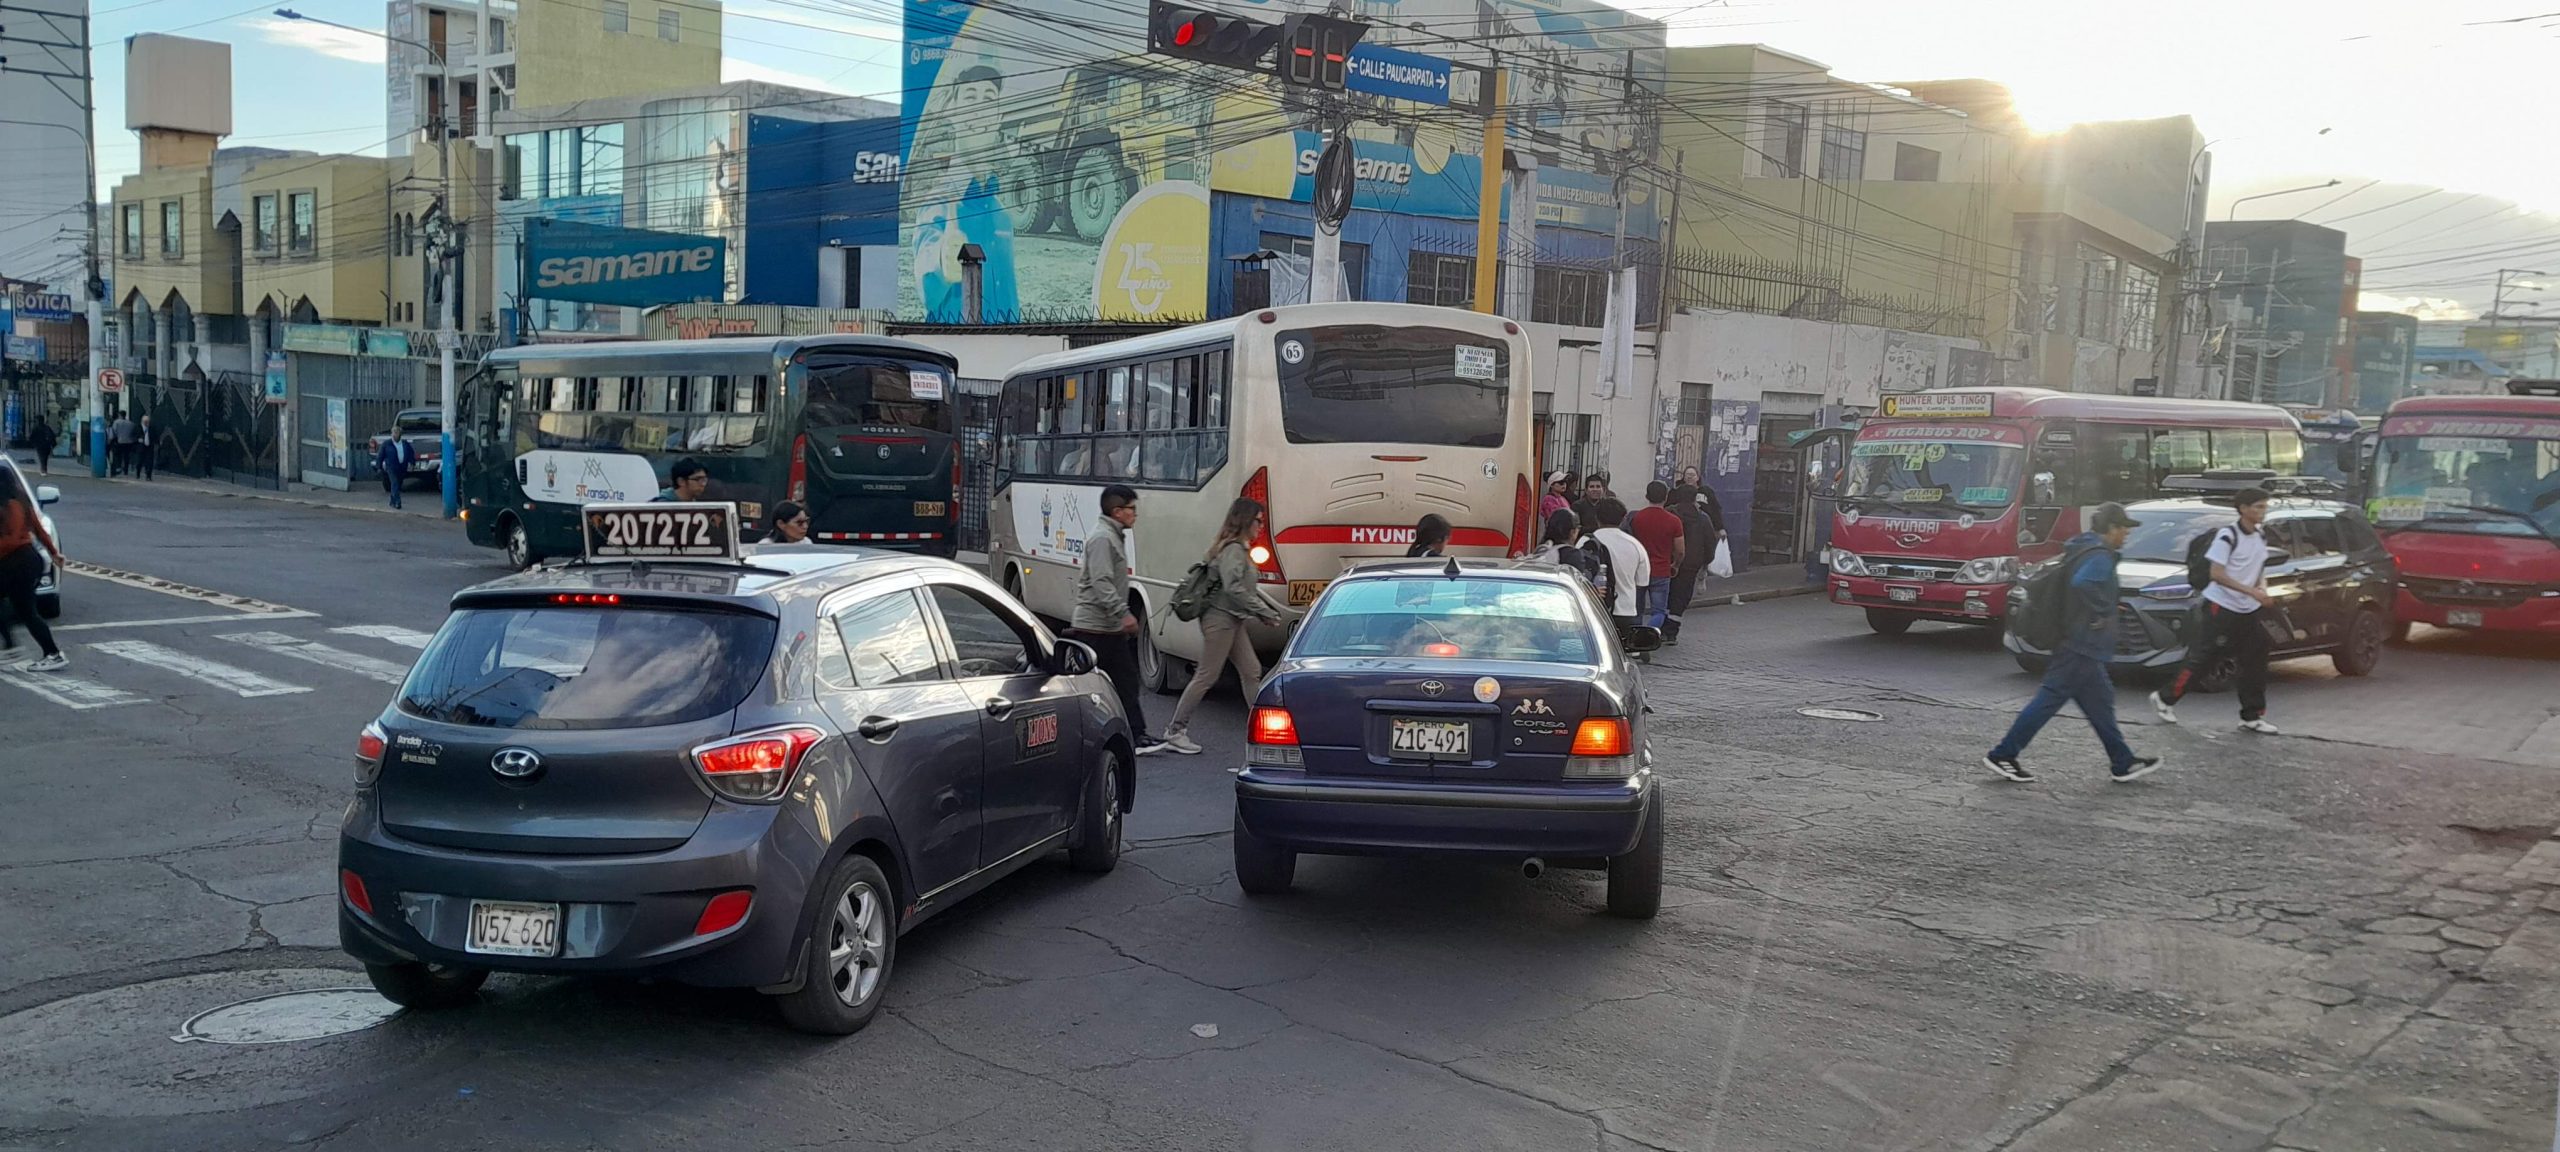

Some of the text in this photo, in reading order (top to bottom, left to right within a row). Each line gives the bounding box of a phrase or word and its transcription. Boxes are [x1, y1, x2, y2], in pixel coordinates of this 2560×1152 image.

[1359, 58, 1435, 88] CALLE PAUCARPATA
[1297, 149, 1412, 185] same
[1553, 185, 1611, 208] INDEPENDENCIA
[537, 245, 714, 289] samame
[16, 294, 71, 310] BOTICA
[1286, 345, 1300, 359] 65
[1883, 397, 1896, 416] C
[1900, 395, 1932, 405] HUNTER
[1937, 395, 1956, 405] UPIS
[1961, 395, 1987, 405] TINGO
[1886, 427, 1990, 440] MEGABUS AQP
[604, 513, 711, 546] 207272
[1351, 527, 1417, 543] HYUND
[1884, 520, 1940, 534] HYUNDAI
[1291, 583, 1328, 601] X2S-
[1027, 714, 1057, 747] LIONS
[1513, 719, 1567, 728] CORSA
[1394, 727, 1467, 753] Z1C-491
[478, 914, 555, 947] V5Z-620
